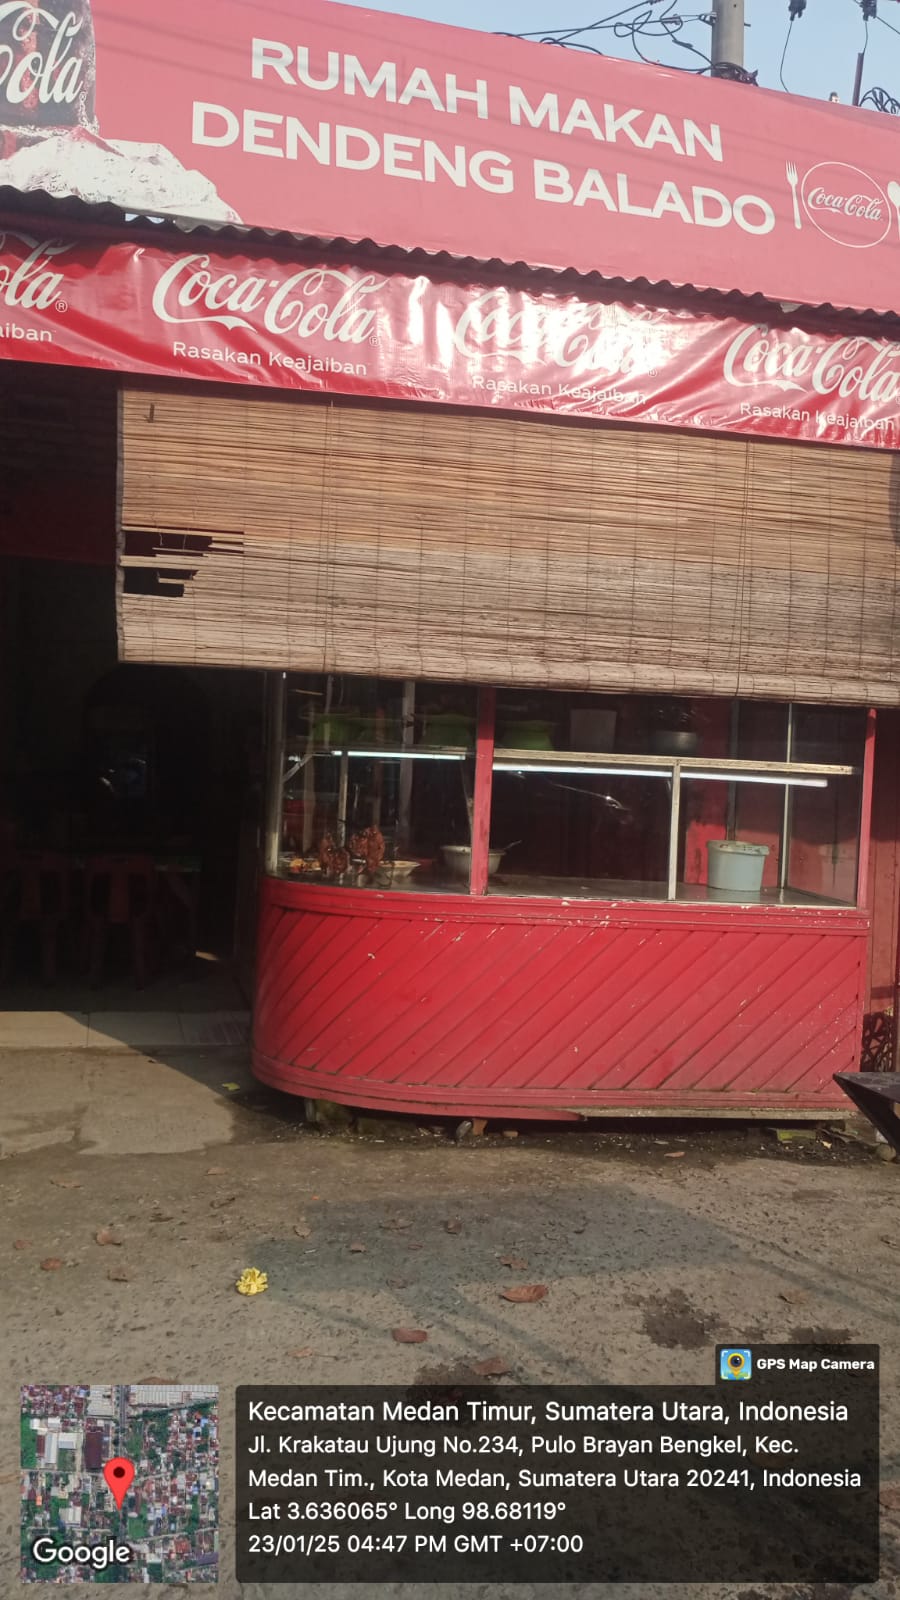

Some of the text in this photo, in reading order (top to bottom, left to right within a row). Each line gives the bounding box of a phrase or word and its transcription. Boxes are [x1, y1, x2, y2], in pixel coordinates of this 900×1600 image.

[251, 38, 724, 163] RUMAH MAKAN
[191, 100, 776, 235] DENDENG BALADO
[807, 187, 884, 220] Coca-Cola
[152, 254, 388, 344] Coca-Cola
[172, 341, 367, 375] Rasakan Keajaiban
[472, 374, 552, 395] Rasakan
[723, 323, 900, 402] Coca-Cola
[740, 402, 810, 422] Rasakan
